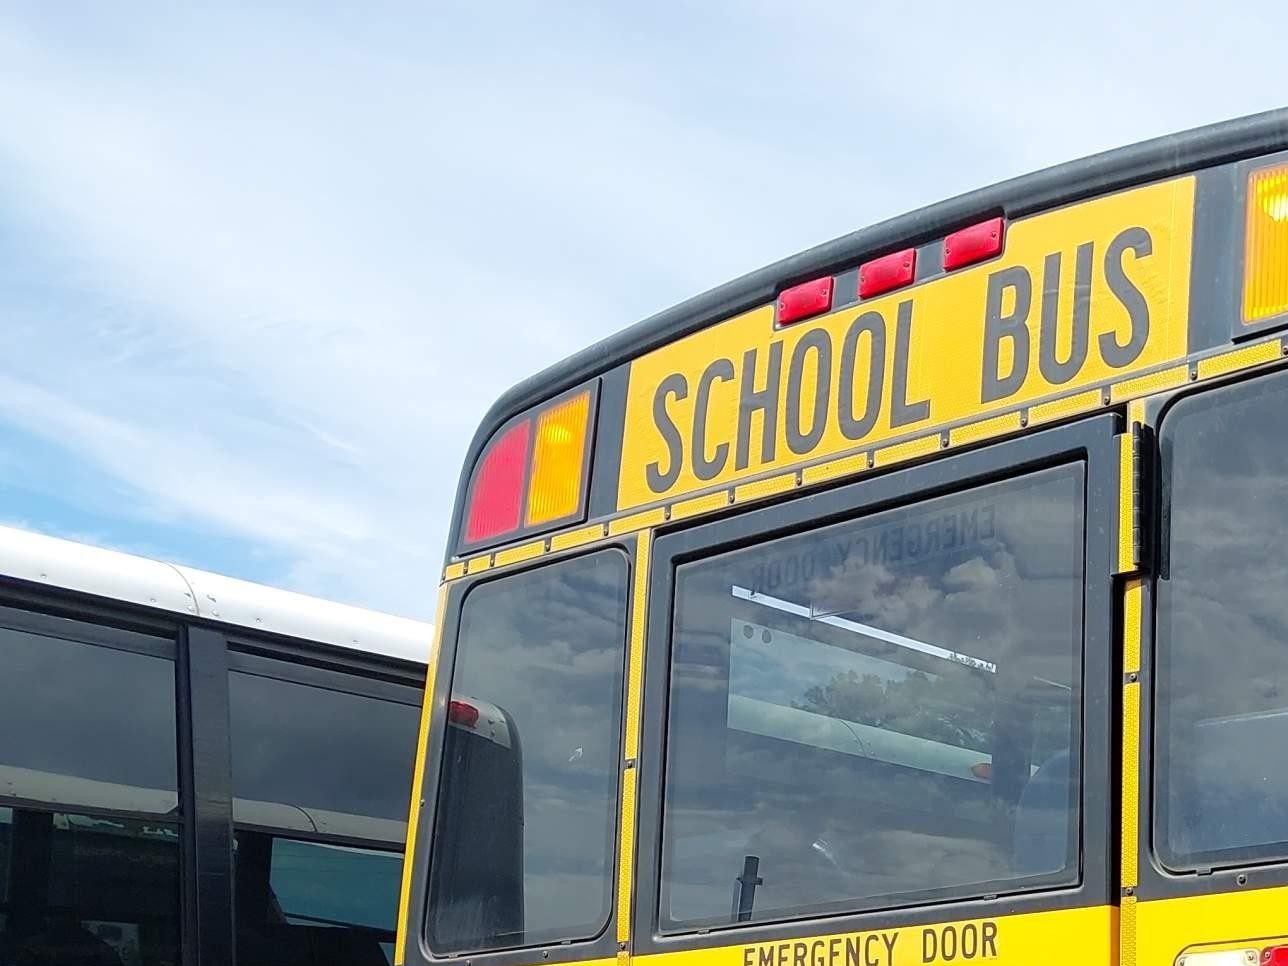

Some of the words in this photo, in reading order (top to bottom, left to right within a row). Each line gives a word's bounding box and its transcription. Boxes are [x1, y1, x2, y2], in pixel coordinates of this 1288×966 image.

[646, 299, 931, 494] SCHOOL
[980, 226, 1153, 405] BUS
[922, 921, 998, 964] DOOR
